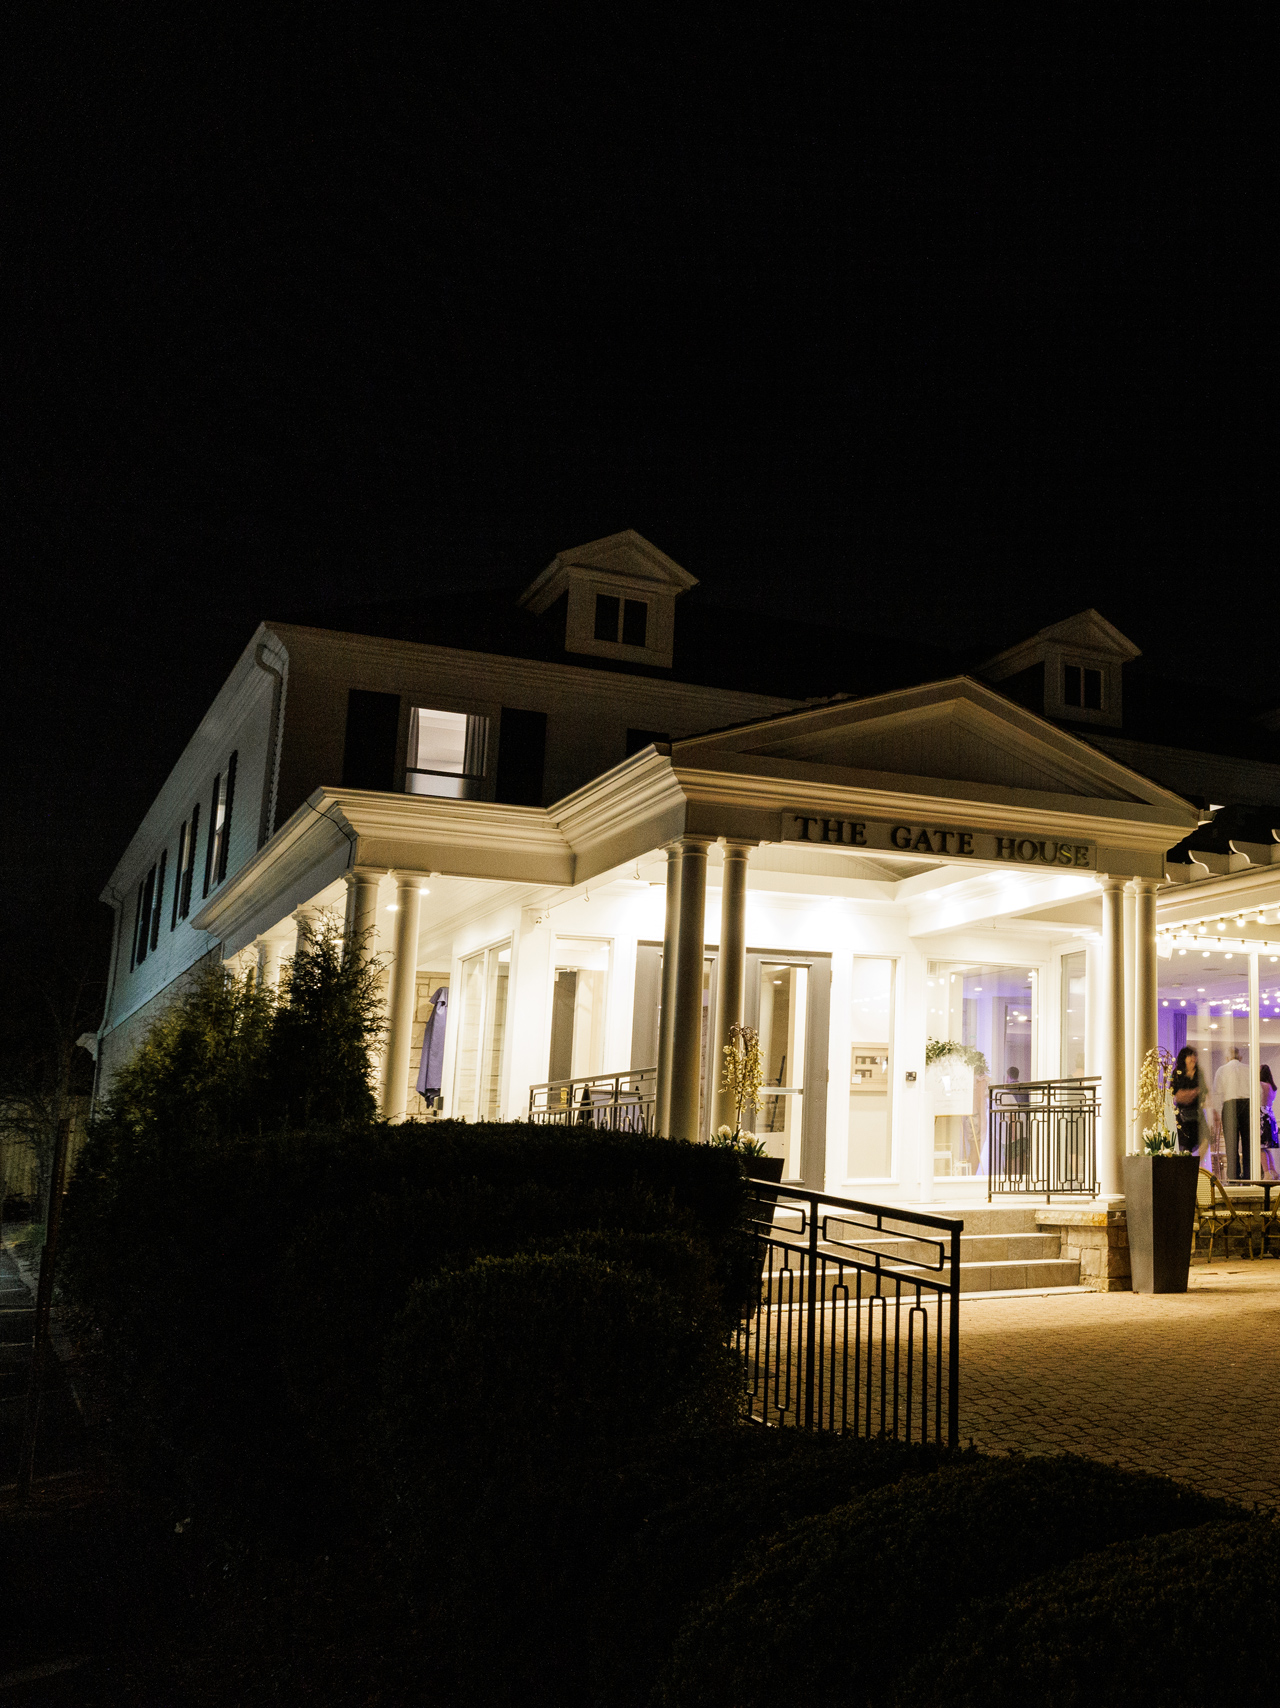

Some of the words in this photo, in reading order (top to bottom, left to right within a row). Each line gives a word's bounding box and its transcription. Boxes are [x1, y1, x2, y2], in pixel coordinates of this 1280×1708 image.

[794, 816, 867, 845] THE
[890, 826, 974, 855] GATE
[994, 836, 1090, 867] HOUSE
